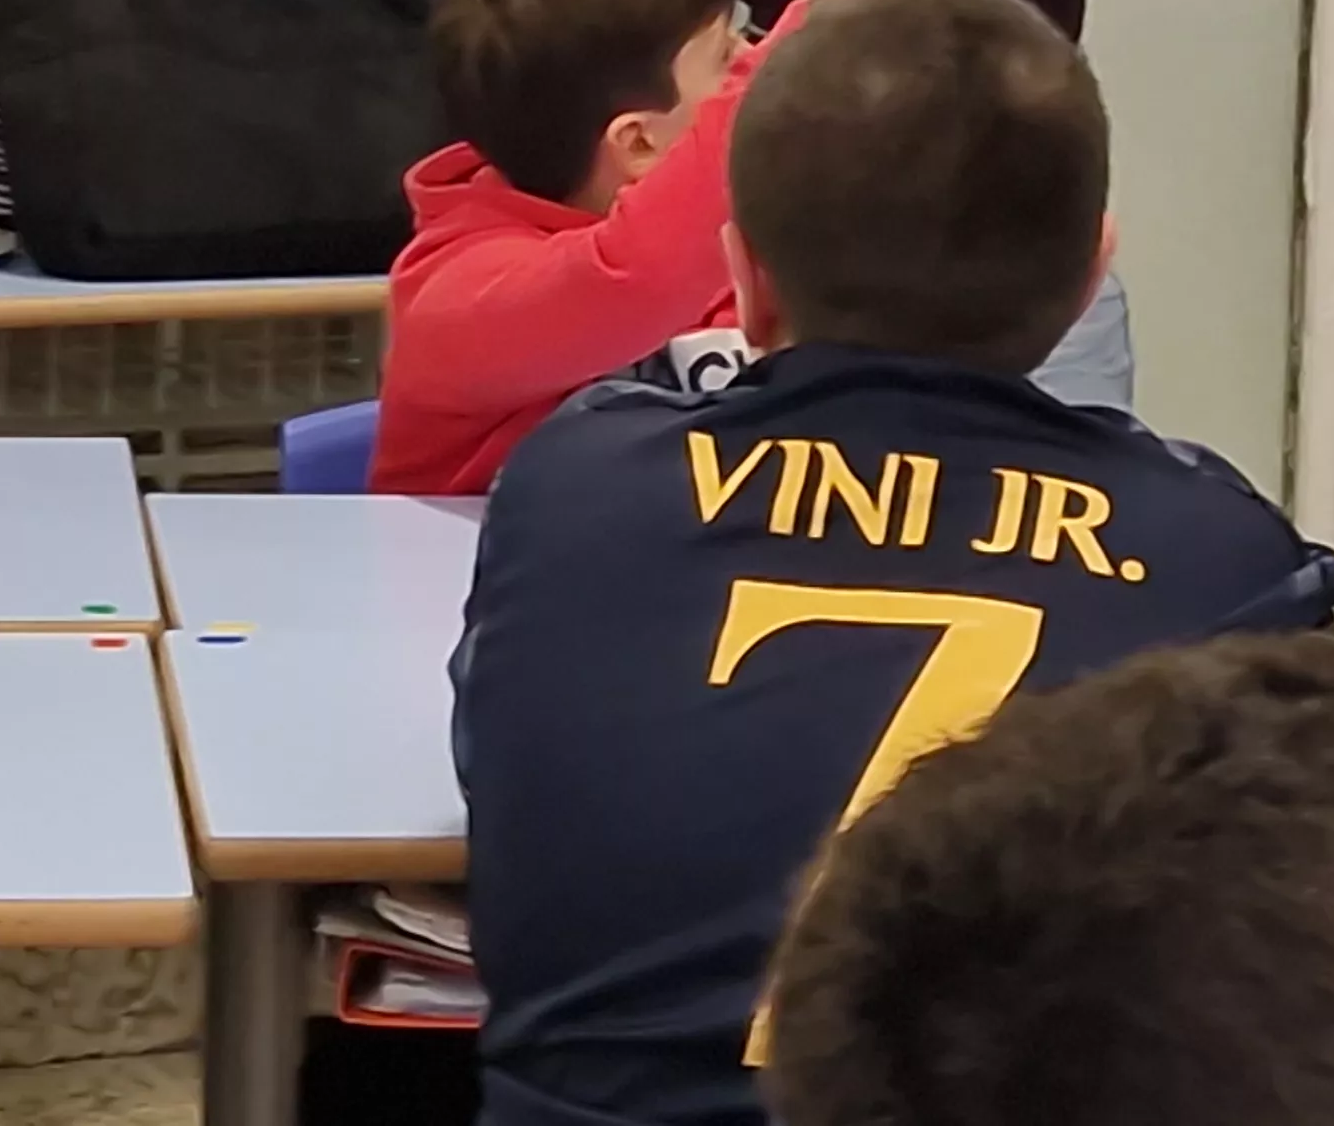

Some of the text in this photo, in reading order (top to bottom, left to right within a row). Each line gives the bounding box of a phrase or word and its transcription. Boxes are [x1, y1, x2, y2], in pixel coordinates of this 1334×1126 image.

[688, 431, 1146, 582] VINI JR.
[707, 580, 1043, 1068] 7
